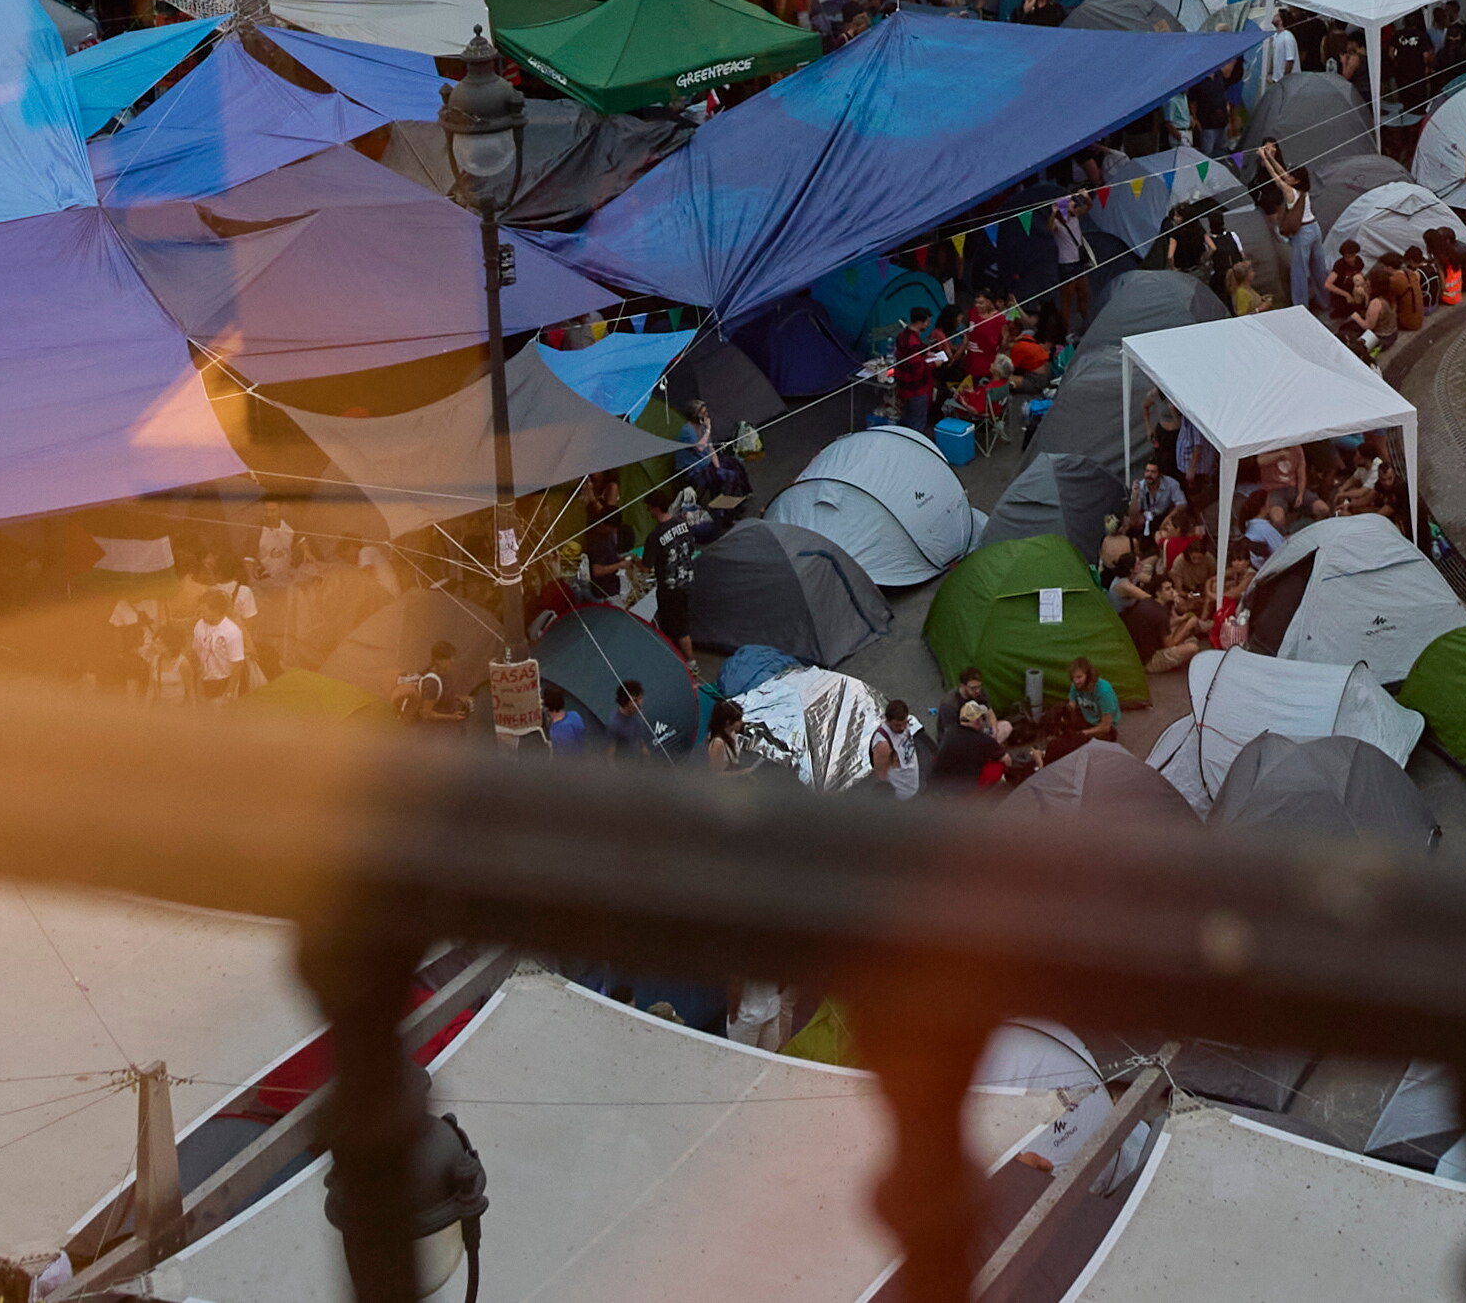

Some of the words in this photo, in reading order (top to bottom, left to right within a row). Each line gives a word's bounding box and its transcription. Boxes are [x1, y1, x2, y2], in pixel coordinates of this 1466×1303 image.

[676, 57, 755, 87] GREENPEACE
[659, 530, 673, 546] ONE
[671, 522, 689, 538] PIECE
